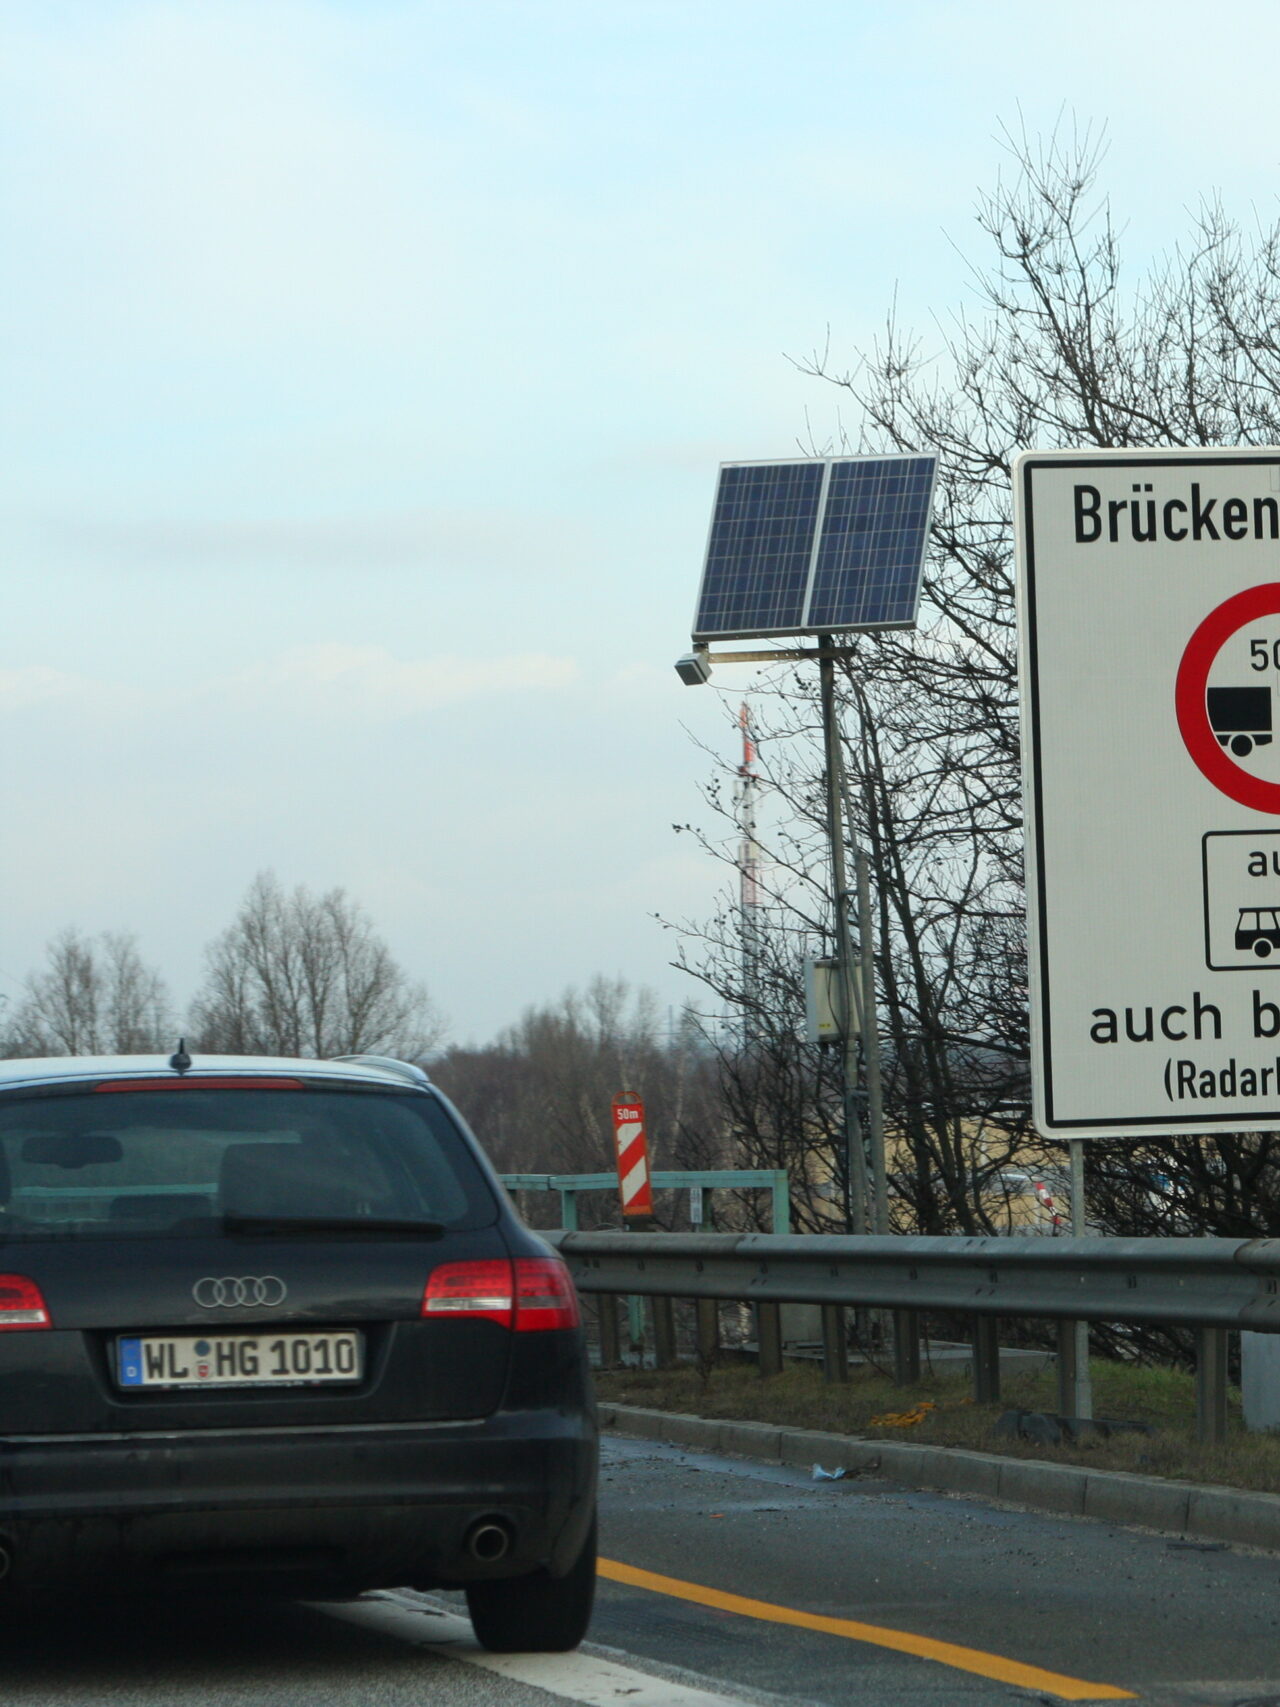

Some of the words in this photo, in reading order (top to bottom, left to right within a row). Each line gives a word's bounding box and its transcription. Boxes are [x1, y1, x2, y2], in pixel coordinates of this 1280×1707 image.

[1089, 992, 1222, 1044] auch
[617, 1108, 639, 1121] 50m
[145, 1343, 189, 1379] WL
[216, 1340, 259, 1377] HG
[269, 1338, 355, 1376] 1010
